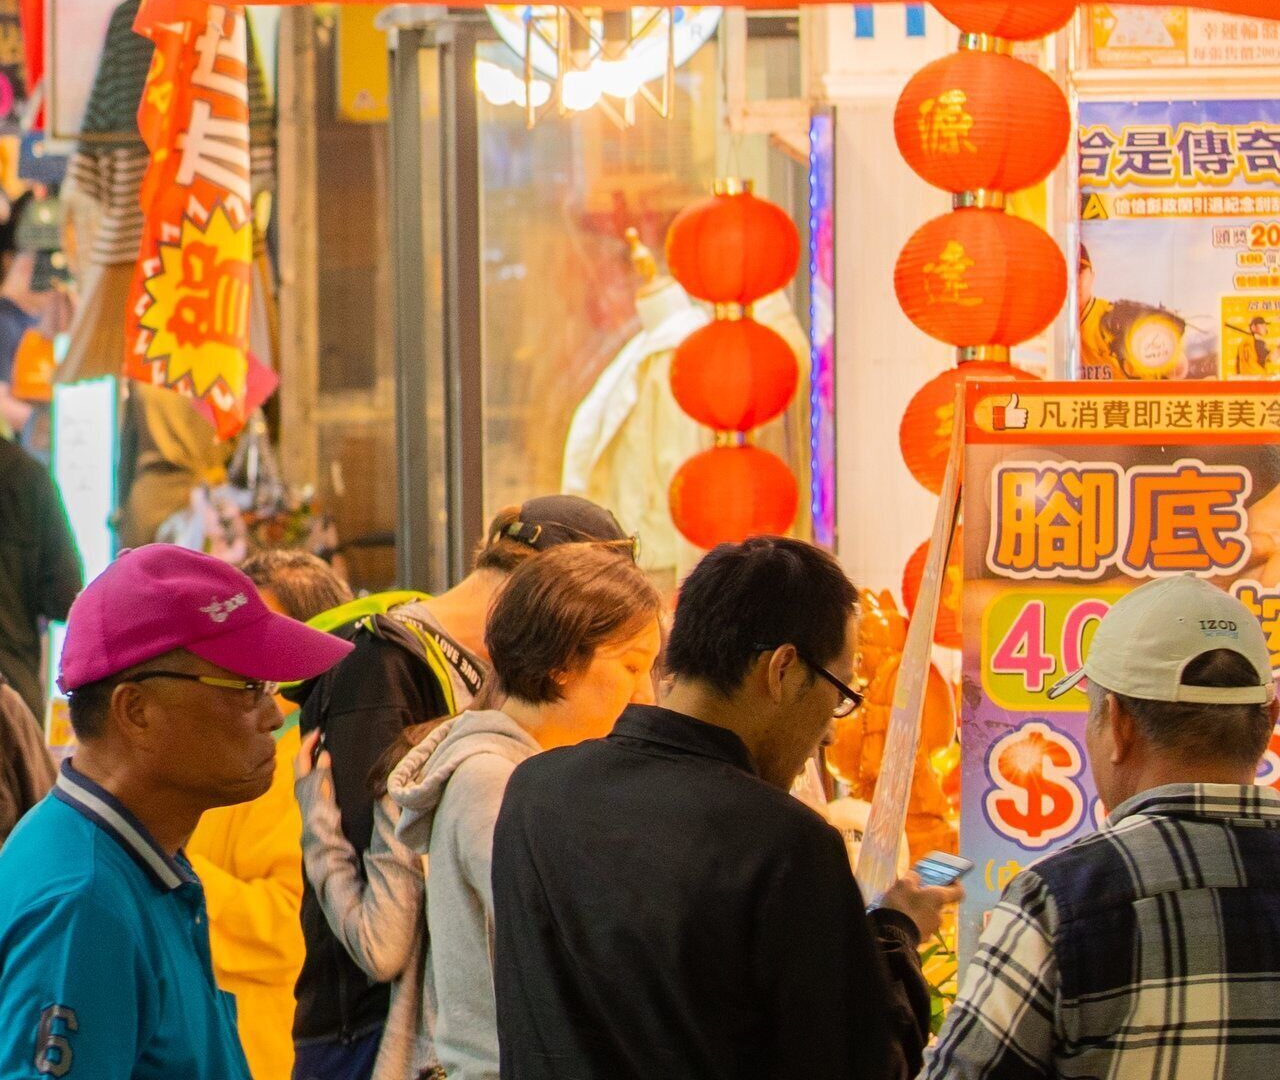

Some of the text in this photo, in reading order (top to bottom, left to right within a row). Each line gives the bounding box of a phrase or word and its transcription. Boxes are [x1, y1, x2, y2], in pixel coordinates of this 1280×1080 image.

[996, 467, 1248, 573] 腳底
[1199, 619, 1238, 632] IZOD
[34, 1004, 80, 1079] 6
